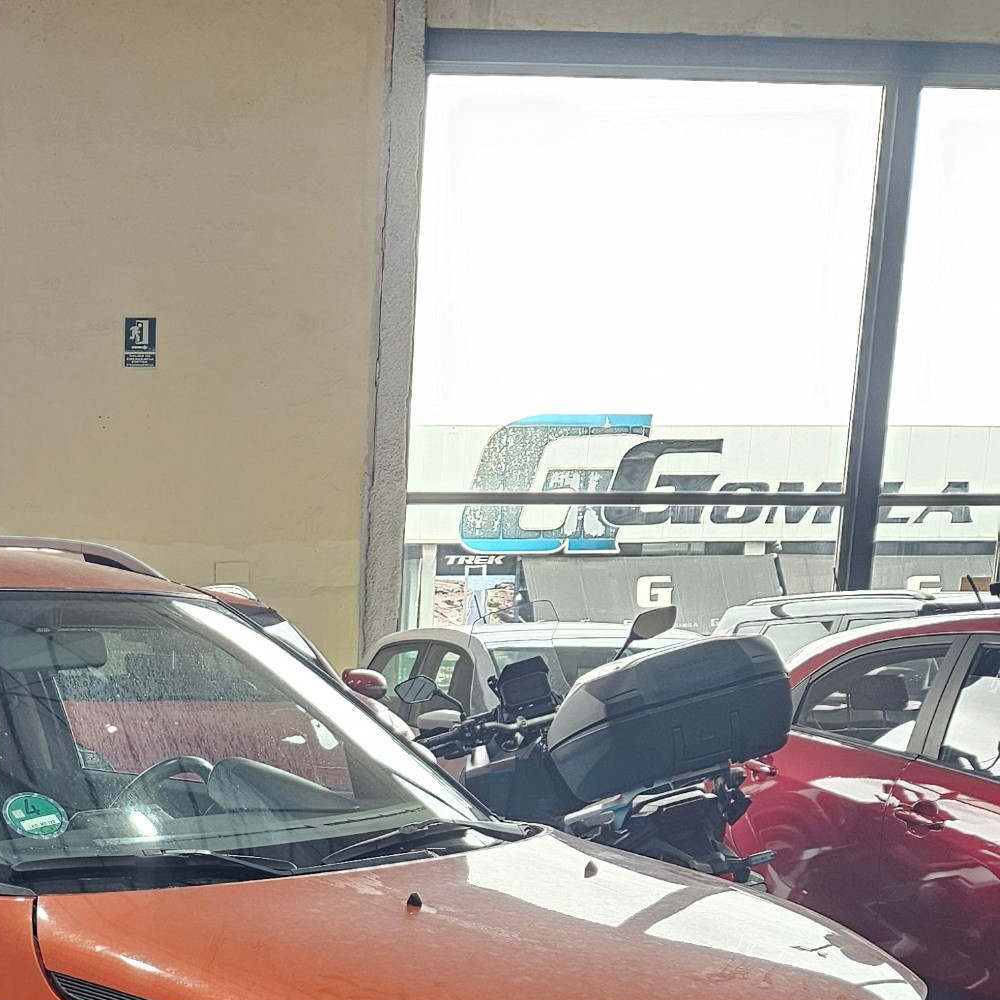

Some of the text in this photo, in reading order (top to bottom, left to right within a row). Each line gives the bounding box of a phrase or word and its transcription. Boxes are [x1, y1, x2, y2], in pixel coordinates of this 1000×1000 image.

[444, 555, 506, 566] TREK
[636, 575, 673, 608] G
[24, 799, 40, 815] 4
